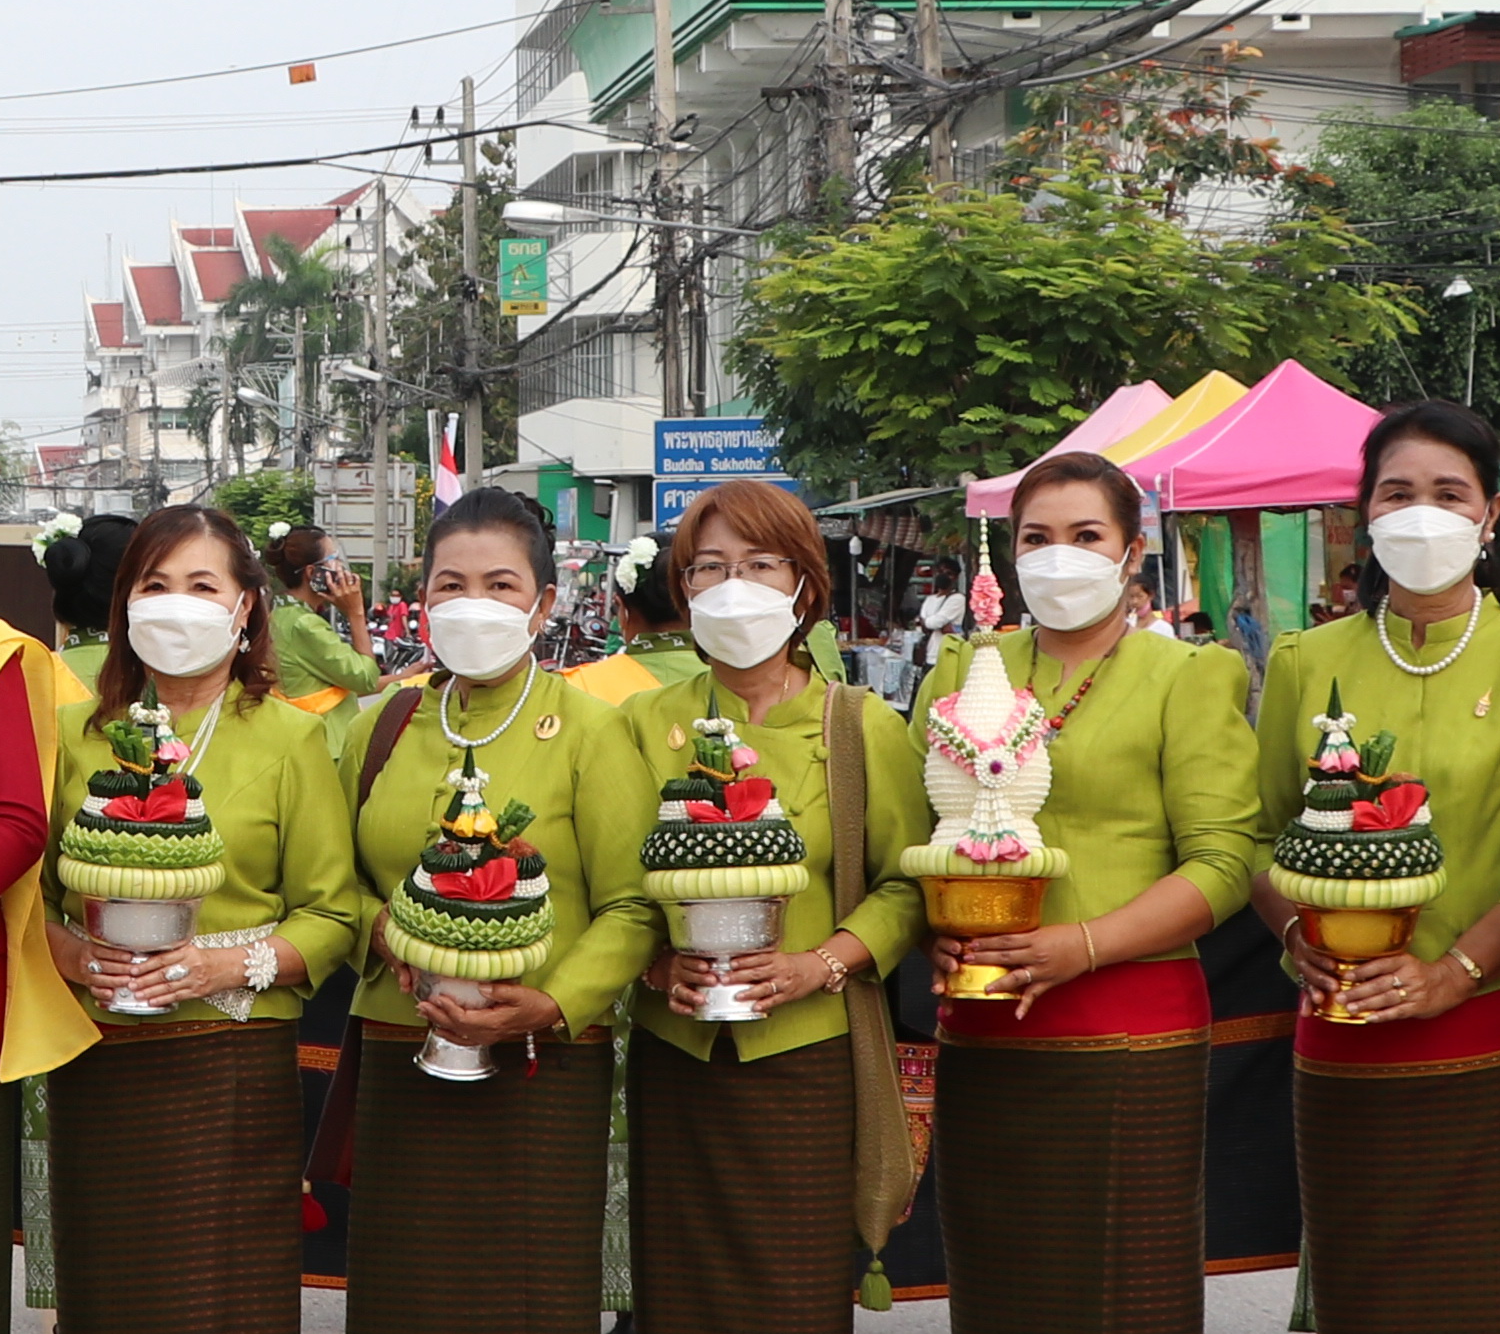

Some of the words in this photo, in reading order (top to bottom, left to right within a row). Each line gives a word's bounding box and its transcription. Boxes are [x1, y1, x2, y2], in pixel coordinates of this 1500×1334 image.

[508, 242, 542, 256] ธกส
[663, 458, 704, 472] Buddha
[711, 456, 766, 471] Sukhothai
